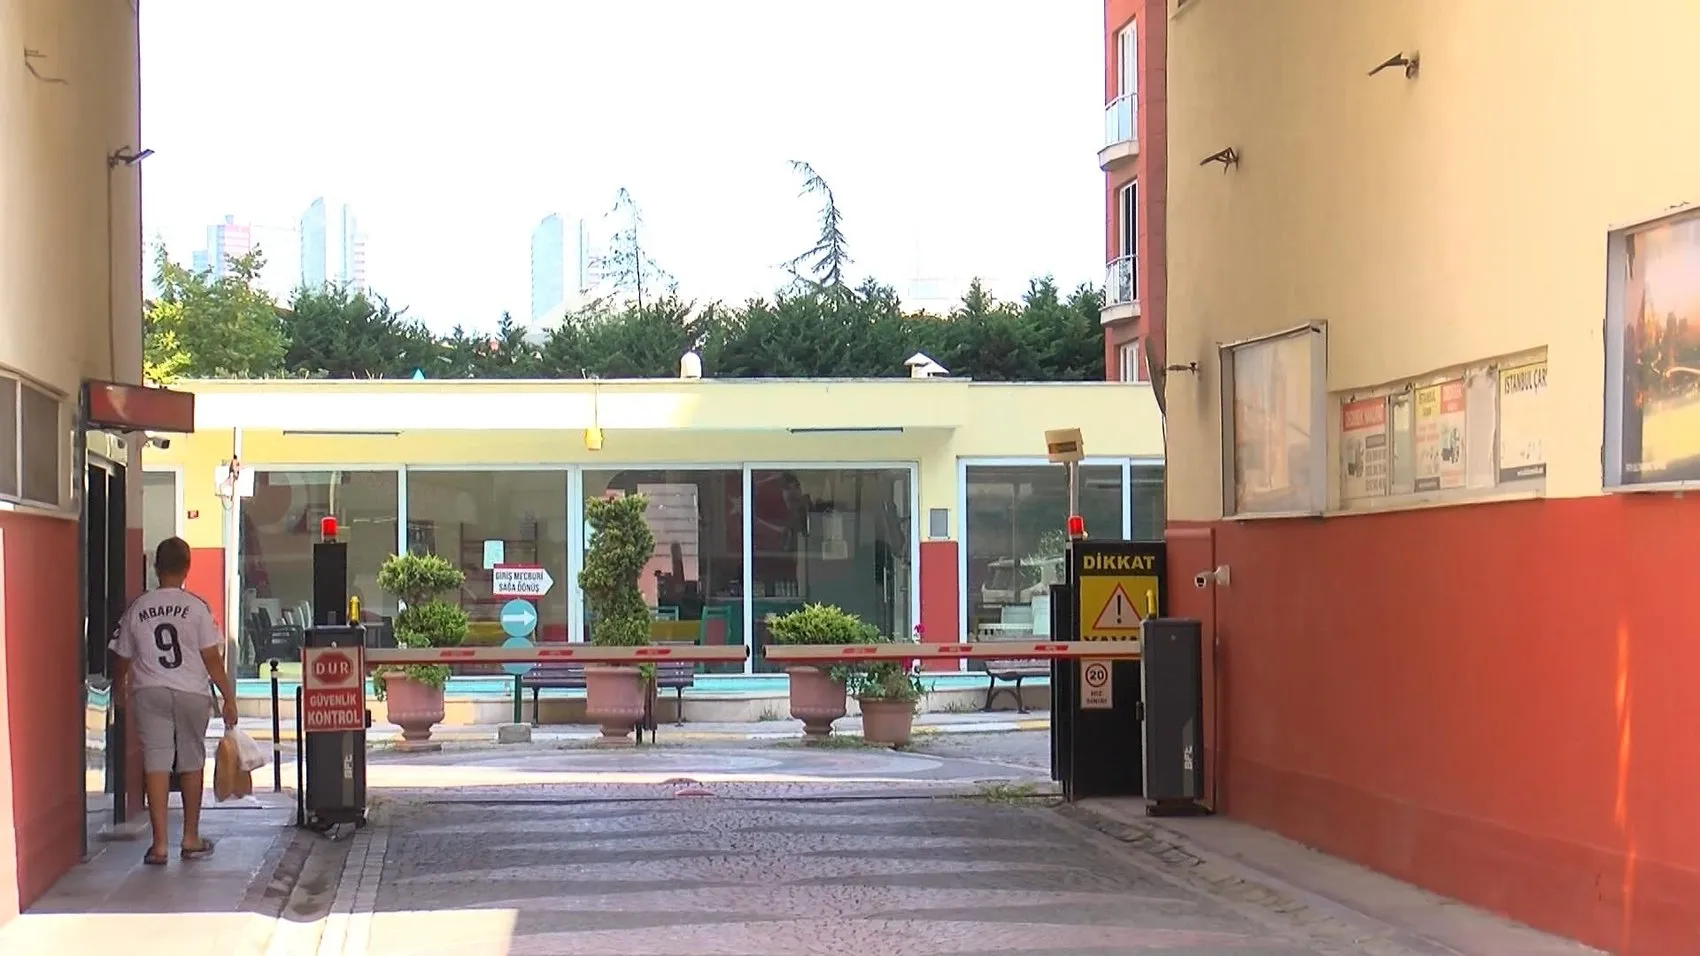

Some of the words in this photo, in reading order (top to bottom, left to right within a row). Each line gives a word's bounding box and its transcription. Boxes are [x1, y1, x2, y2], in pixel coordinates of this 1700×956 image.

[1083, 552, 1155, 570] DİKKAT
[139, 605, 190, 622] MBAPPÉ
[154, 623, 183, 669] 9
[316, 662, 349, 675] DUR
[1090, 669, 1104, 681] 20
[310, 693, 357, 707] GÜVENLİK
[307, 709, 360, 725] KONTROL
